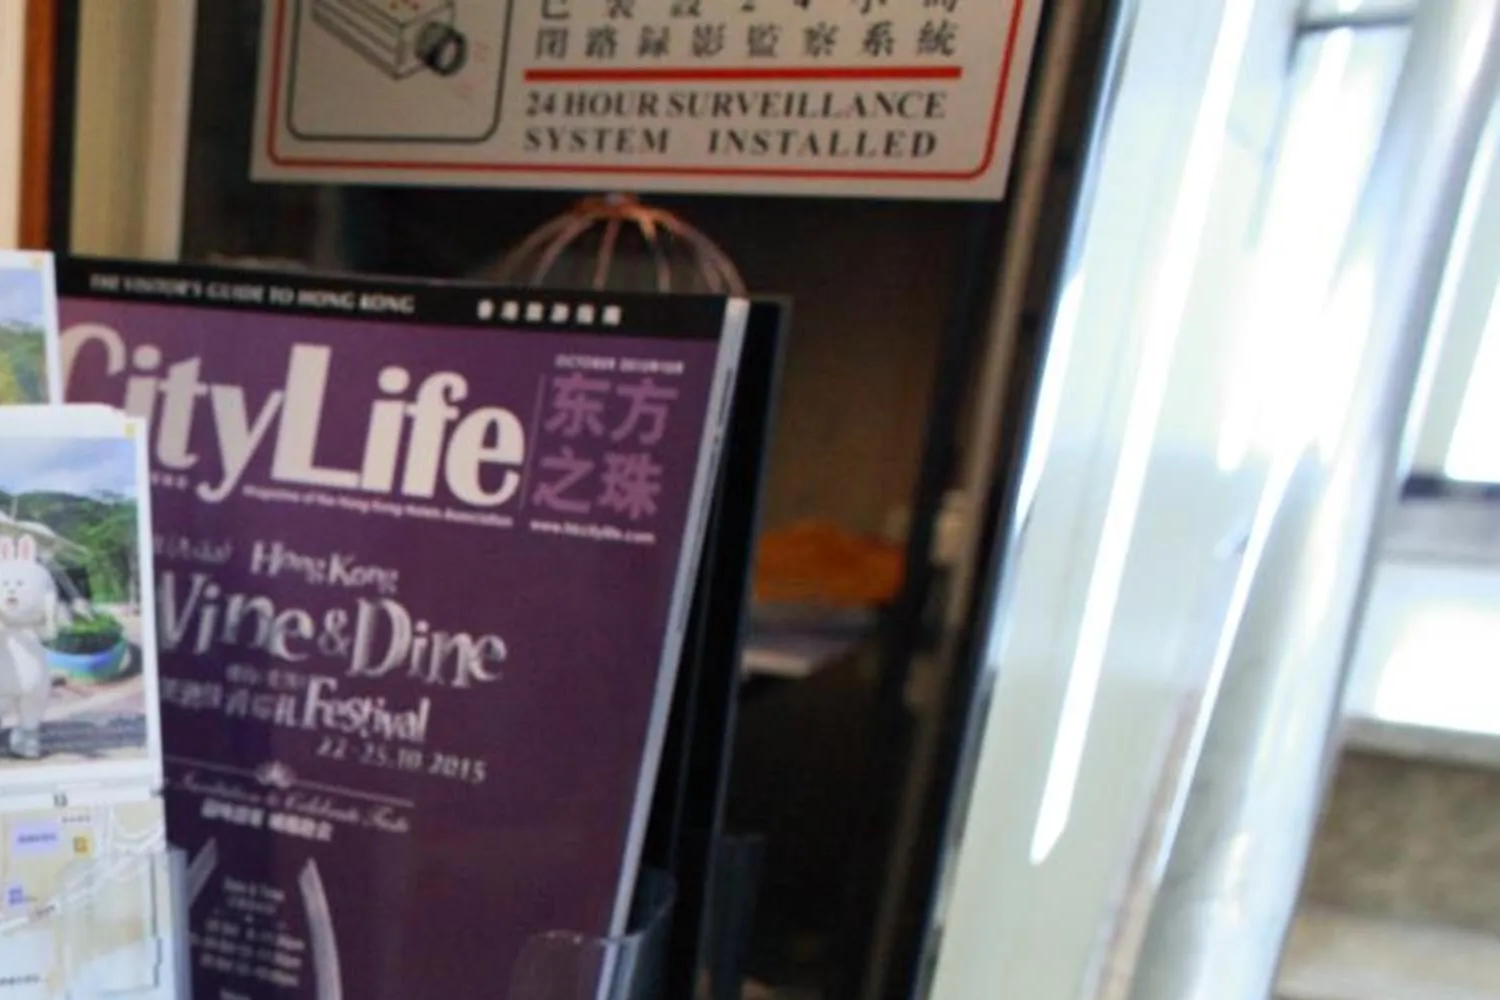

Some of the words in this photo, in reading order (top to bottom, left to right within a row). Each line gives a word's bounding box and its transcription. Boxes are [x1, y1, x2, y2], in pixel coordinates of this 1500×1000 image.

[526, 90, 556, 118] 24
[563, 90, 660, 118] HOUR
[668, 90, 947, 120] SURVEILLANCE
[523, 127, 670, 154] SYSTEM
[706, 128, 937, 158] INSTALLED
[269, 286, 294, 305] TO
[59, 322, 526, 508] CityLife
[545, 371, 680, 445] 东方
[531, 446, 663, 521] 之珠
[301, 676, 431, 743] Festival
